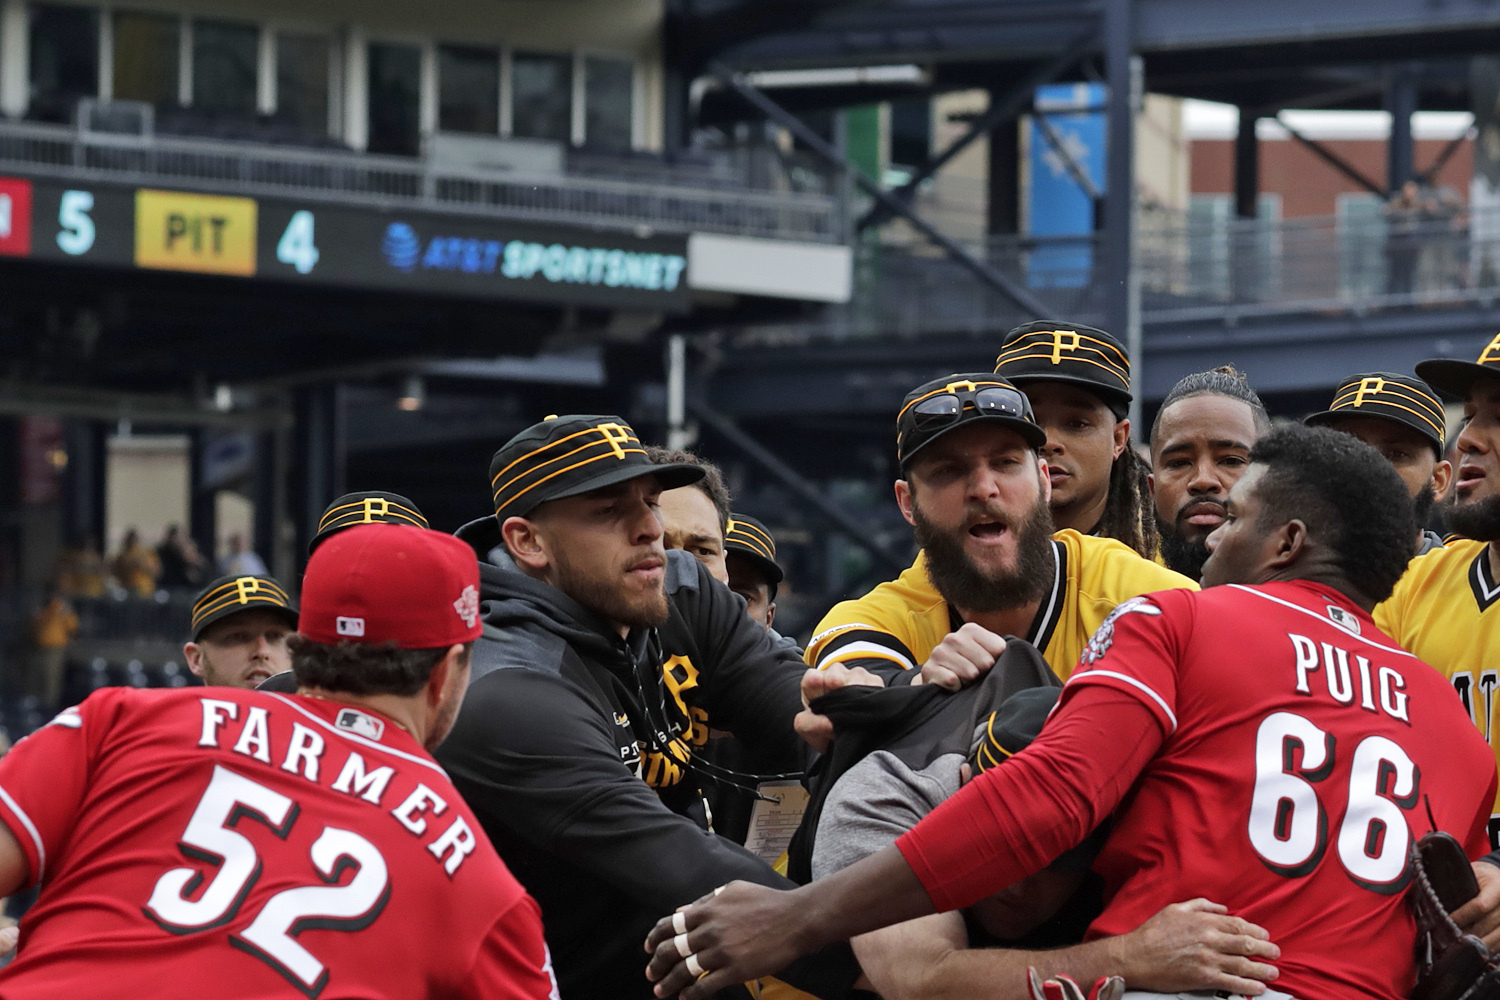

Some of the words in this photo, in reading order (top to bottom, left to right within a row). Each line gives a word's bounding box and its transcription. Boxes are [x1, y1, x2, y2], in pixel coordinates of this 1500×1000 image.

[56, 189, 96, 256] 5
[166, 213, 228, 256] PIT
[276, 209, 320, 275] 4
[421, 236, 504, 273] AT&T
[502, 240, 686, 292] SPORTSNET
[1051, 330, 1080, 365] P
[1353, 377, 1384, 408] P
[597, 422, 629, 460] P
[363, 497, 389, 523] P
[236, 577, 259, 605] P
[1288, 632, 1412, 727] PUIG
[198, 698, 477, 880] FARMER
[1248, 711, 1421, 895] 66
[142, 764, 391, 1000] 52
